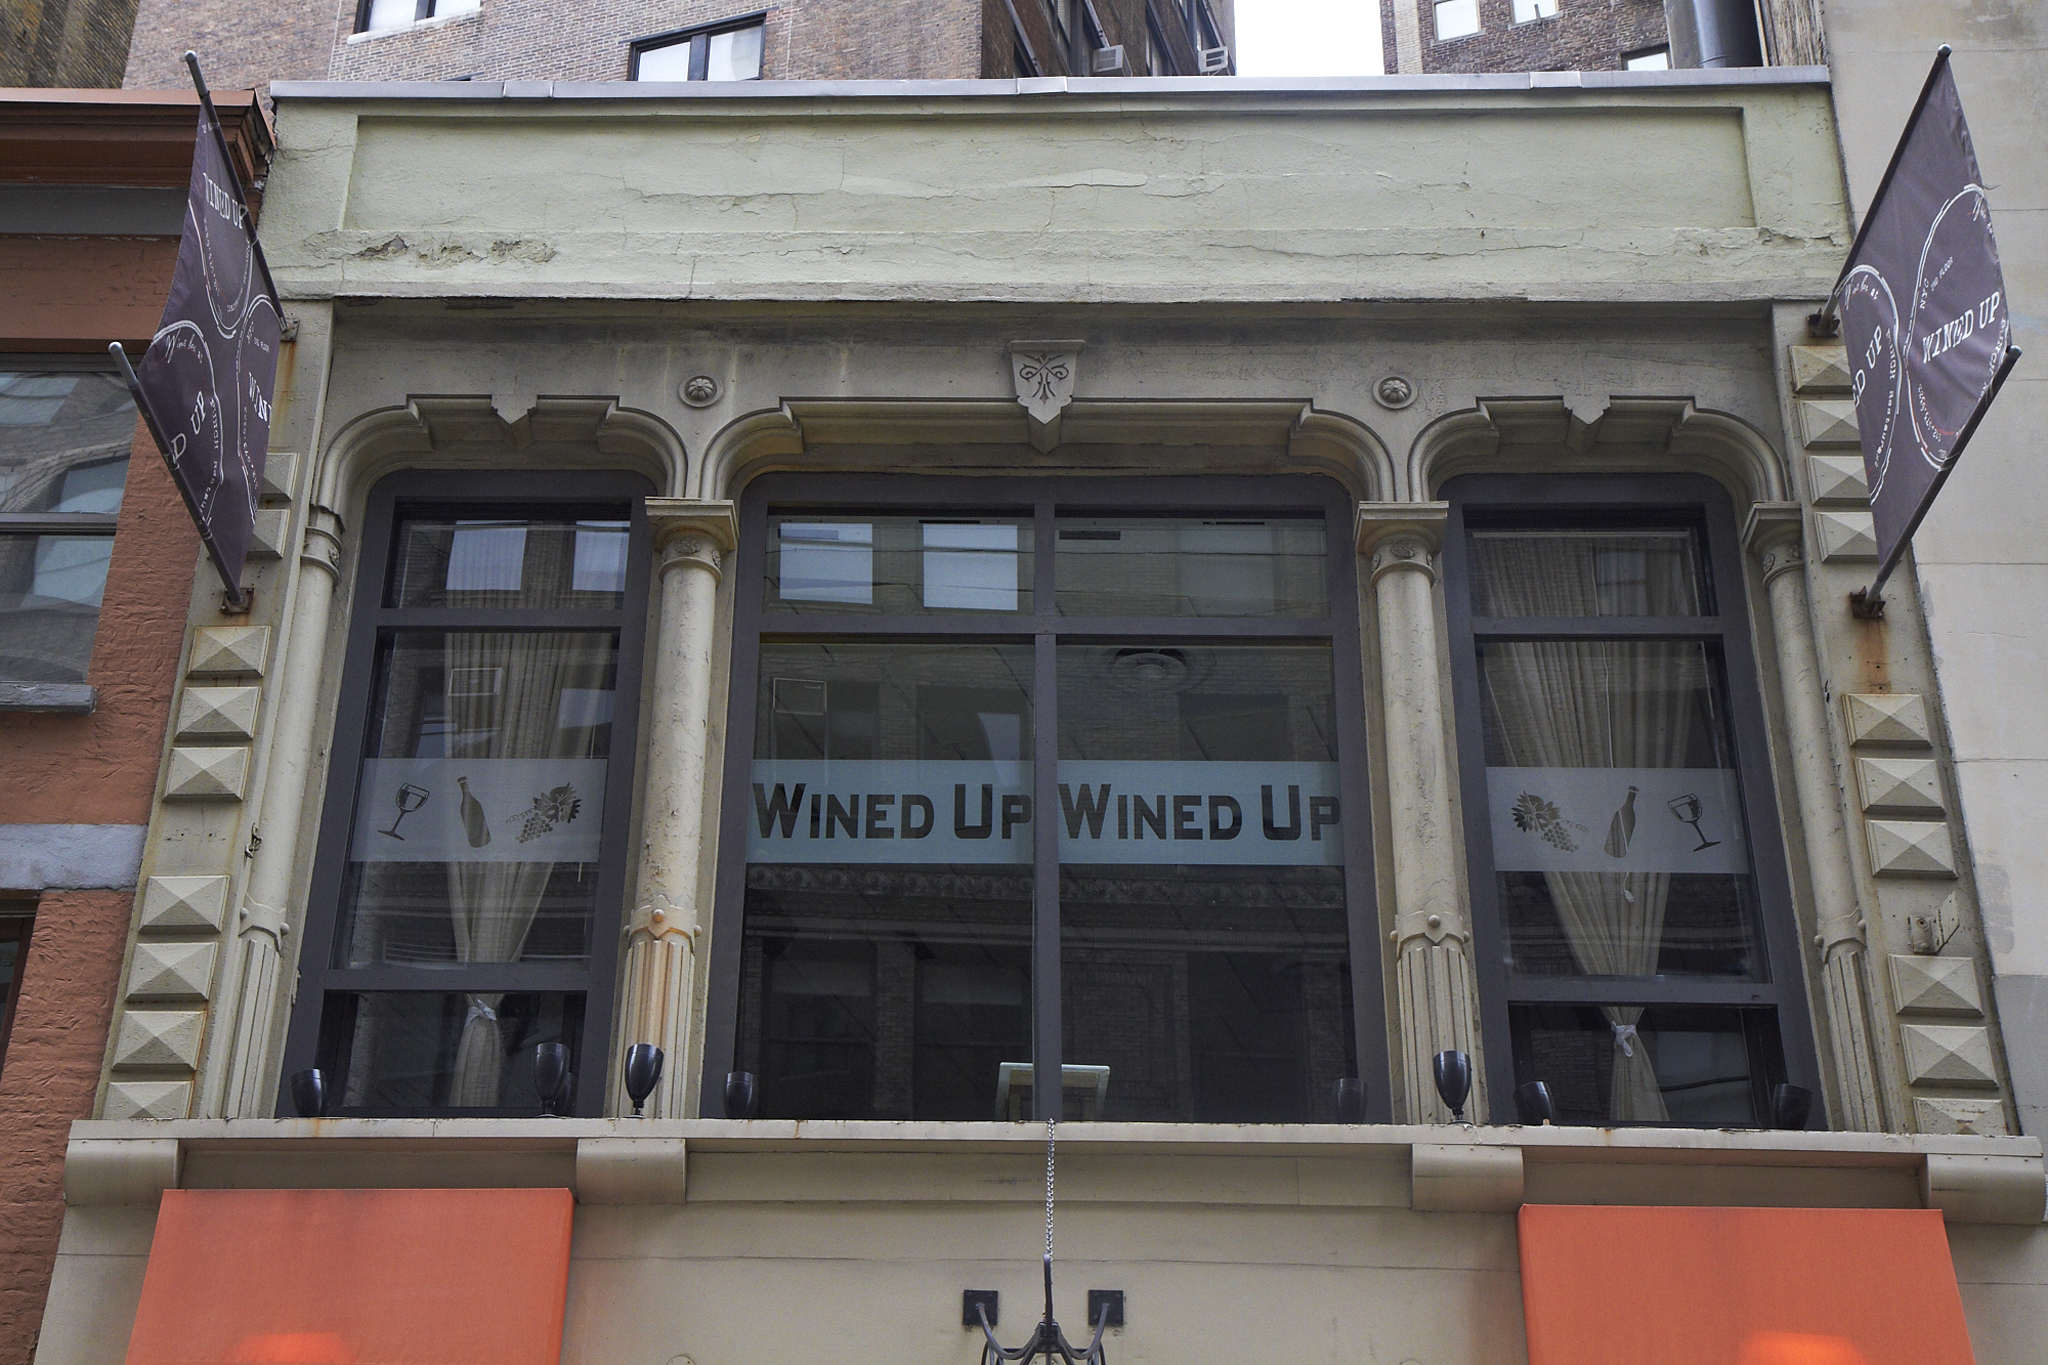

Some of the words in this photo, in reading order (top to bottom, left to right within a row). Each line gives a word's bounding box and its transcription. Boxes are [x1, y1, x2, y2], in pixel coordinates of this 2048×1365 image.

[231, 198, 249, 230] UP
[1919, 277, 1930, 311] NYC
[1866, 325, 1882, 369] UP
[1922, 309, 1974, 364] WINED
[1979, 291, 2000, 330] UP
[190, 391, 207, 435] UP
[752, 783, 934, 840] WINED
[953, 784, 1032, 840] UP
[1058, 785, 1243, 841] WINED
[1260, 784, 1341, 842] UP
